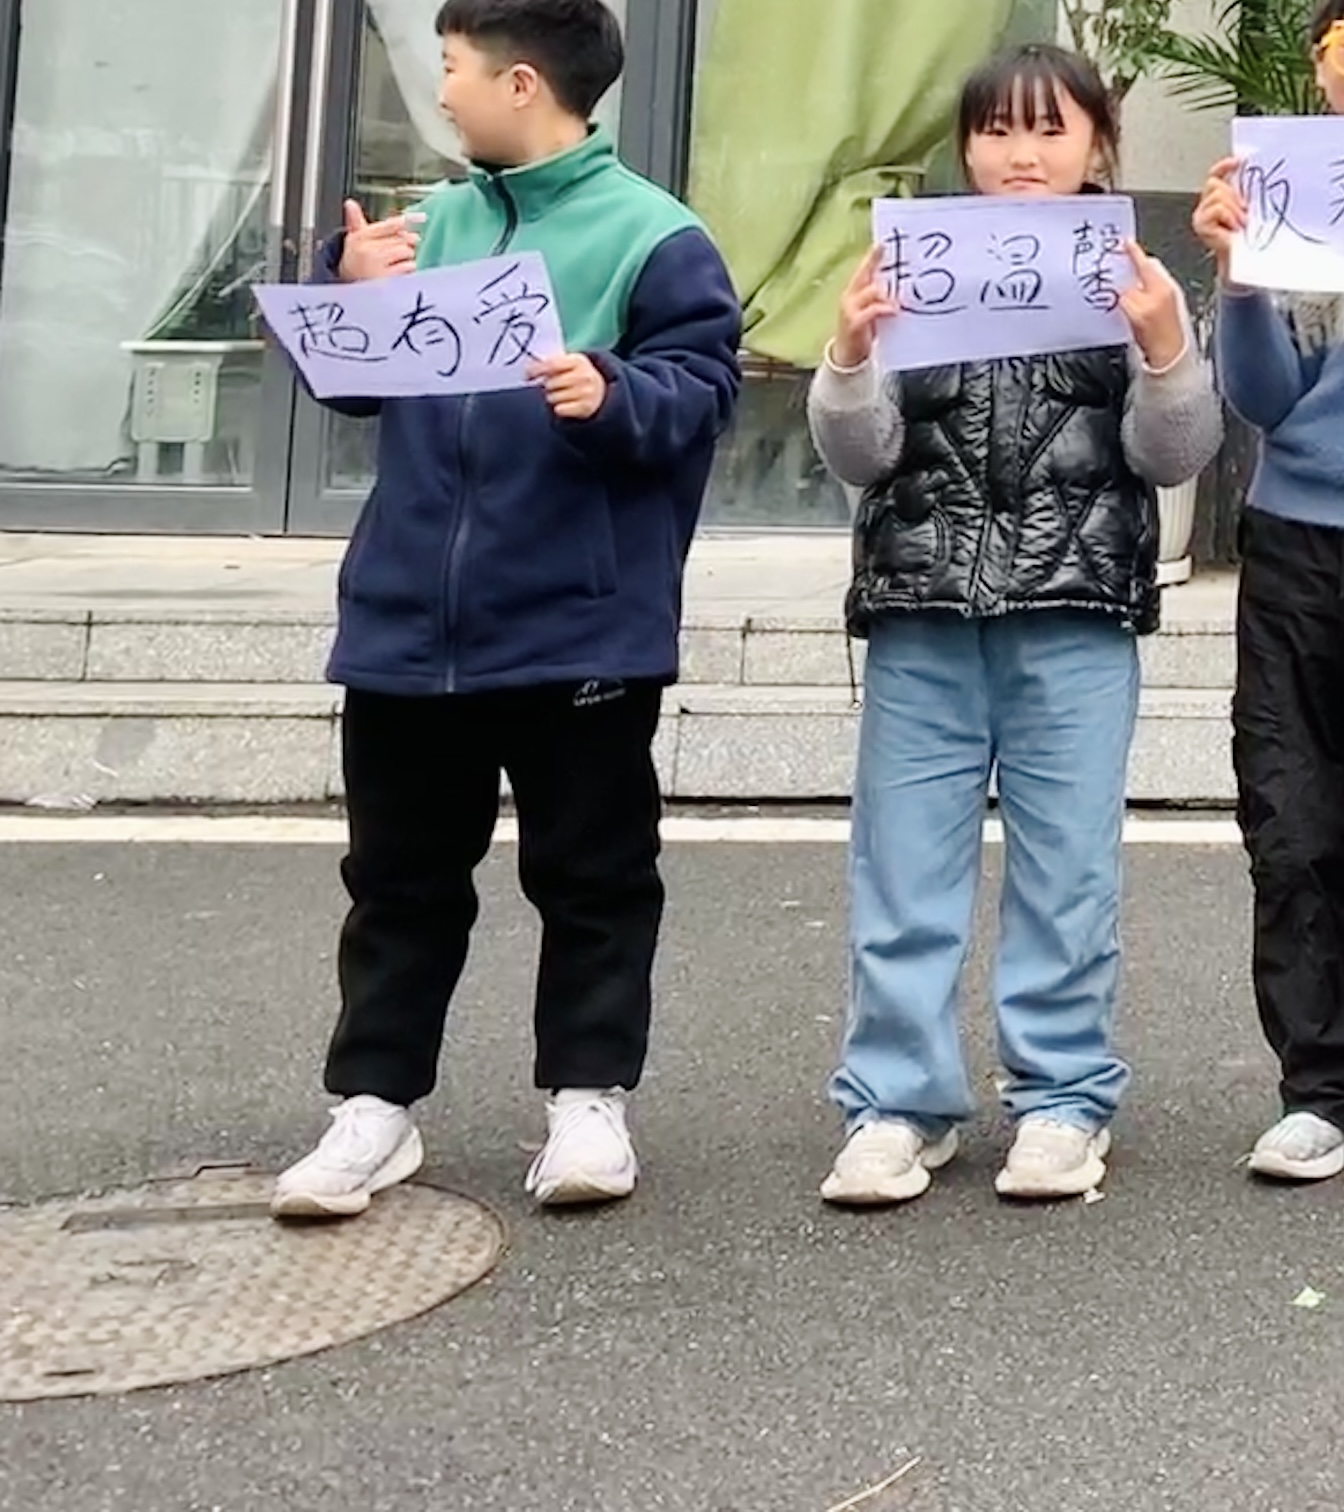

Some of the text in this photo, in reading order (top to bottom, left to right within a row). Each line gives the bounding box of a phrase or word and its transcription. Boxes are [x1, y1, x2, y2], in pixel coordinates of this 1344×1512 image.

[288, 261, 550, 377] 超有爱
[880, 219, 1126, 314] 超温馨
